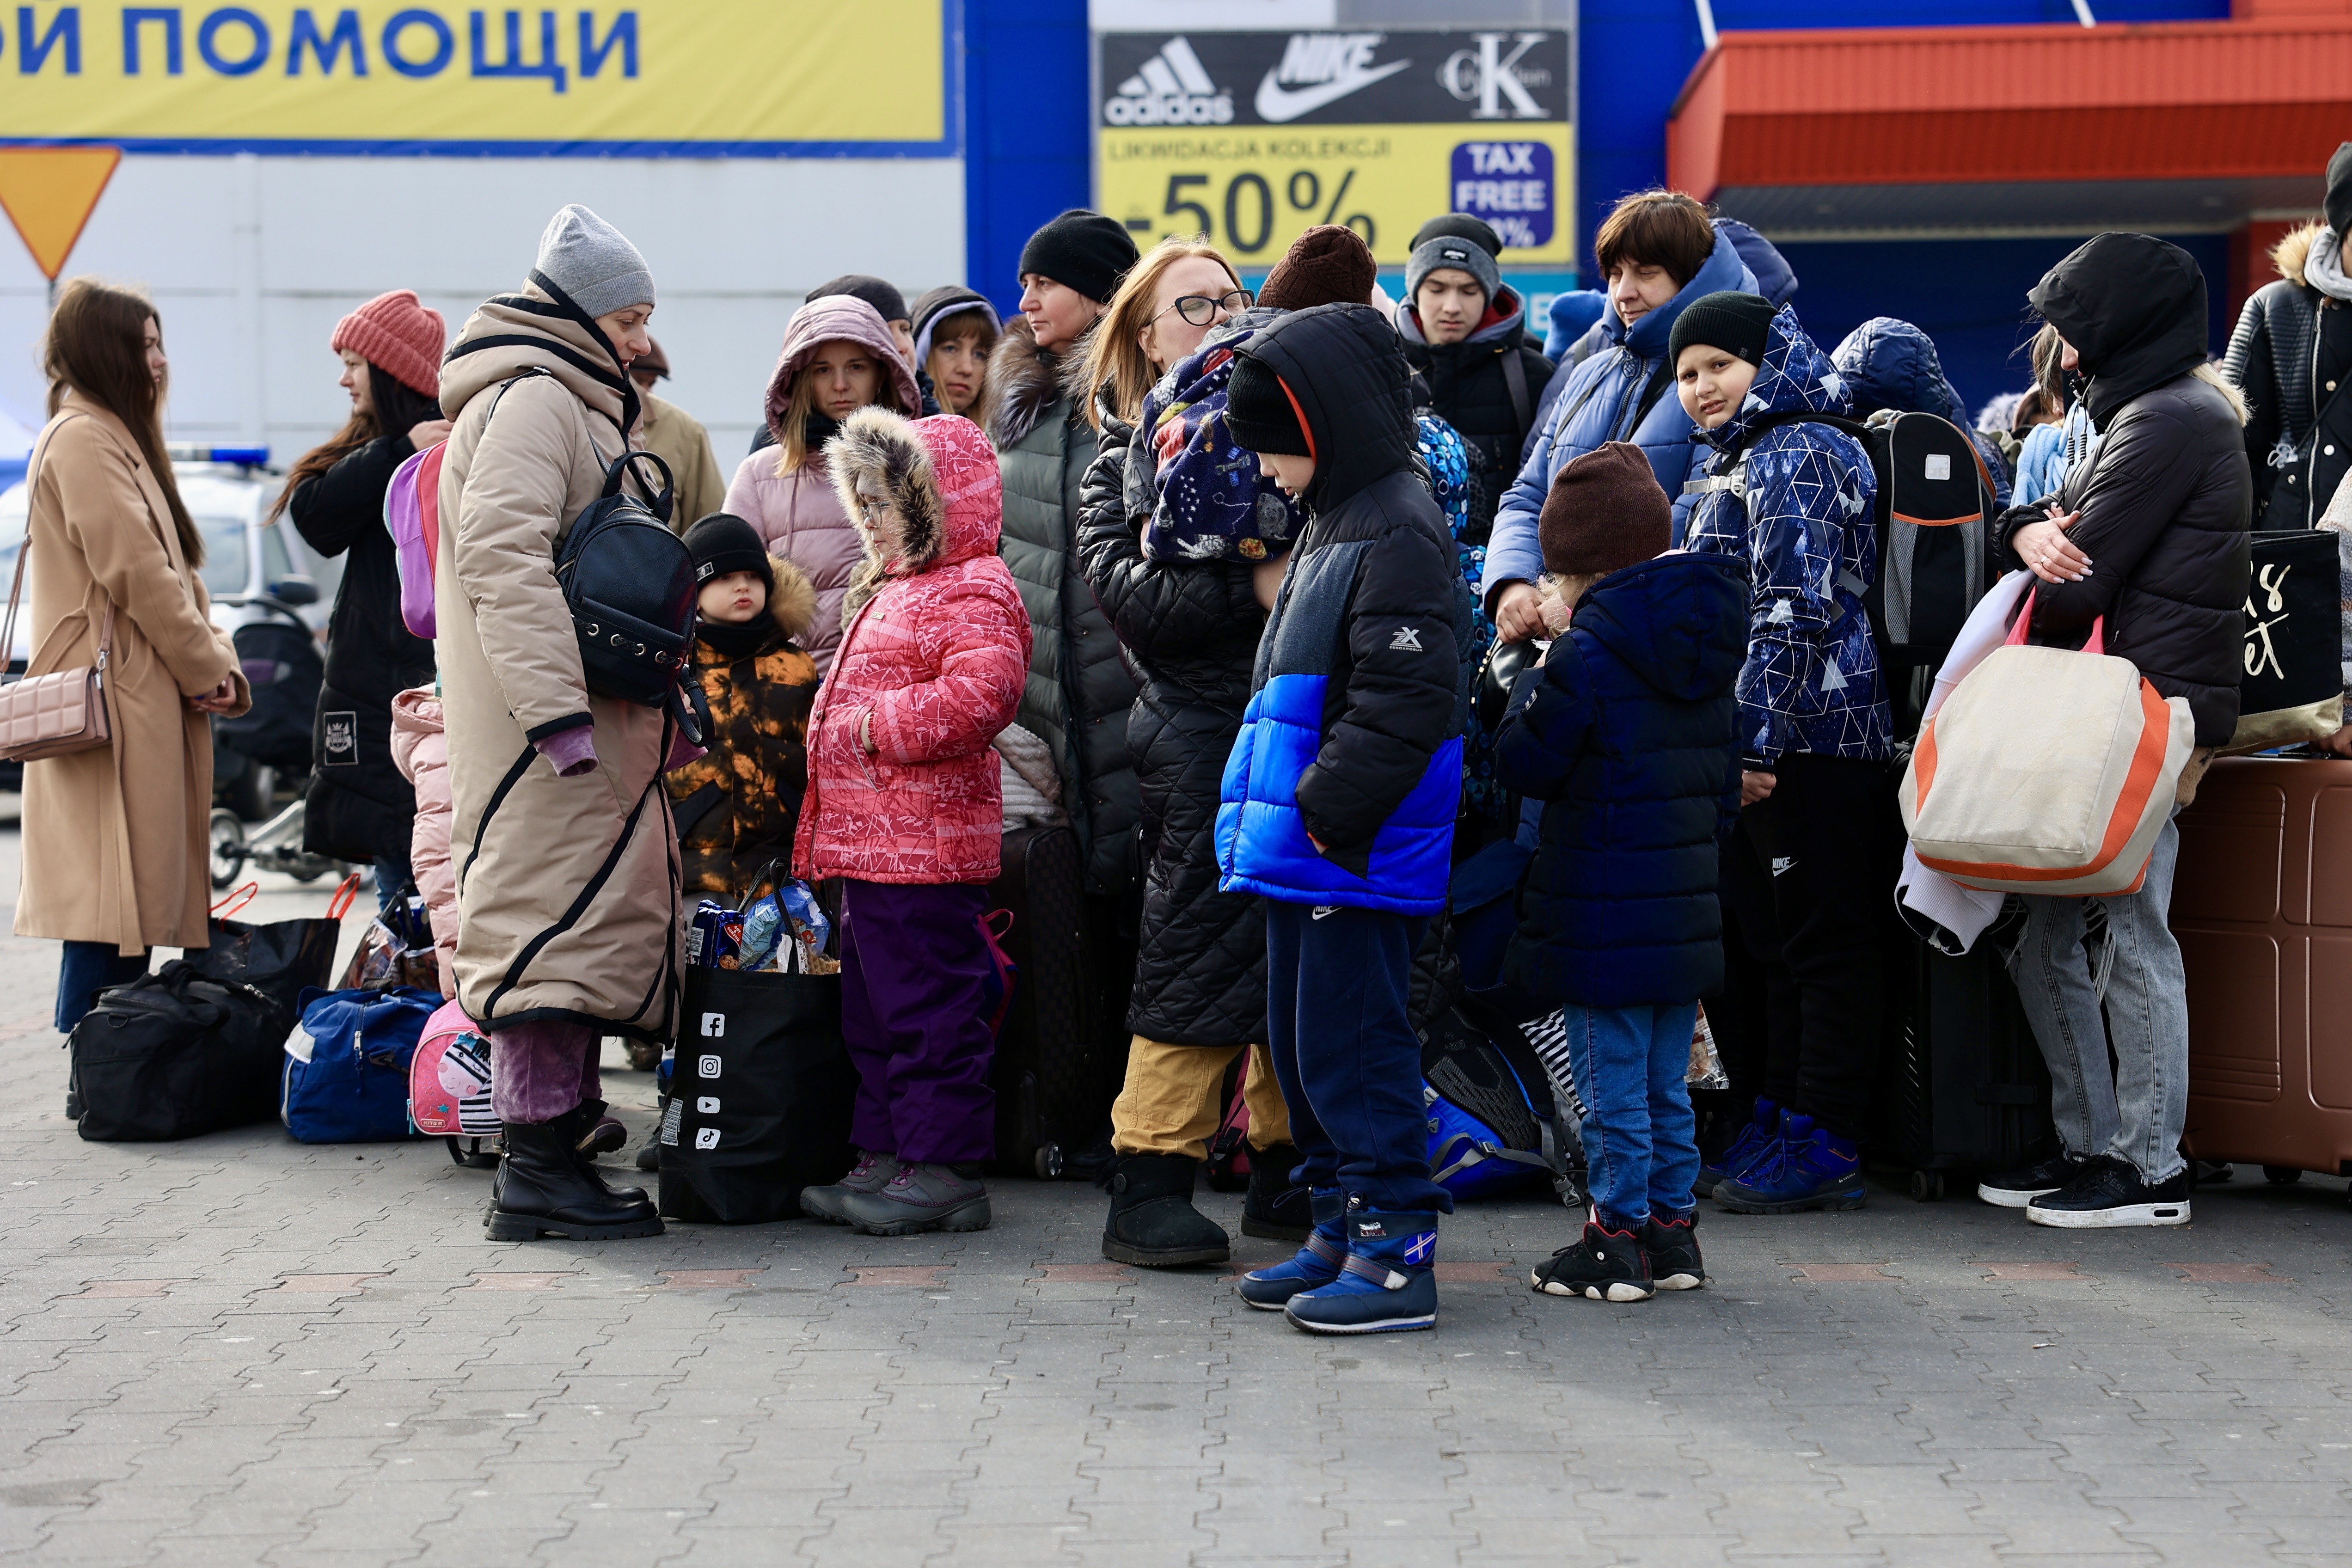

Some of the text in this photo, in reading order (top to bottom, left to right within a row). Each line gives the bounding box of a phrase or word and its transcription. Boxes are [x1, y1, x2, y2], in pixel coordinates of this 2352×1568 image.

[0, 6, 639, 94] Й ПОМОЩИ
[1278, 34, 1382, 84] NIKE
[1105, 92, 1235, 126] adidas
[1111, 138, 1391, 160] LIKWIDACJA KOLEKCJI
[1466, 144, 1536, 175] TAX
[1126, 168, 1375, 254] -50%
[1456, 180, 1547, 212] FREE
[1772, 857, 1790, 869] NIKE
[727, 926, 740, 942] GÜNSTIG
